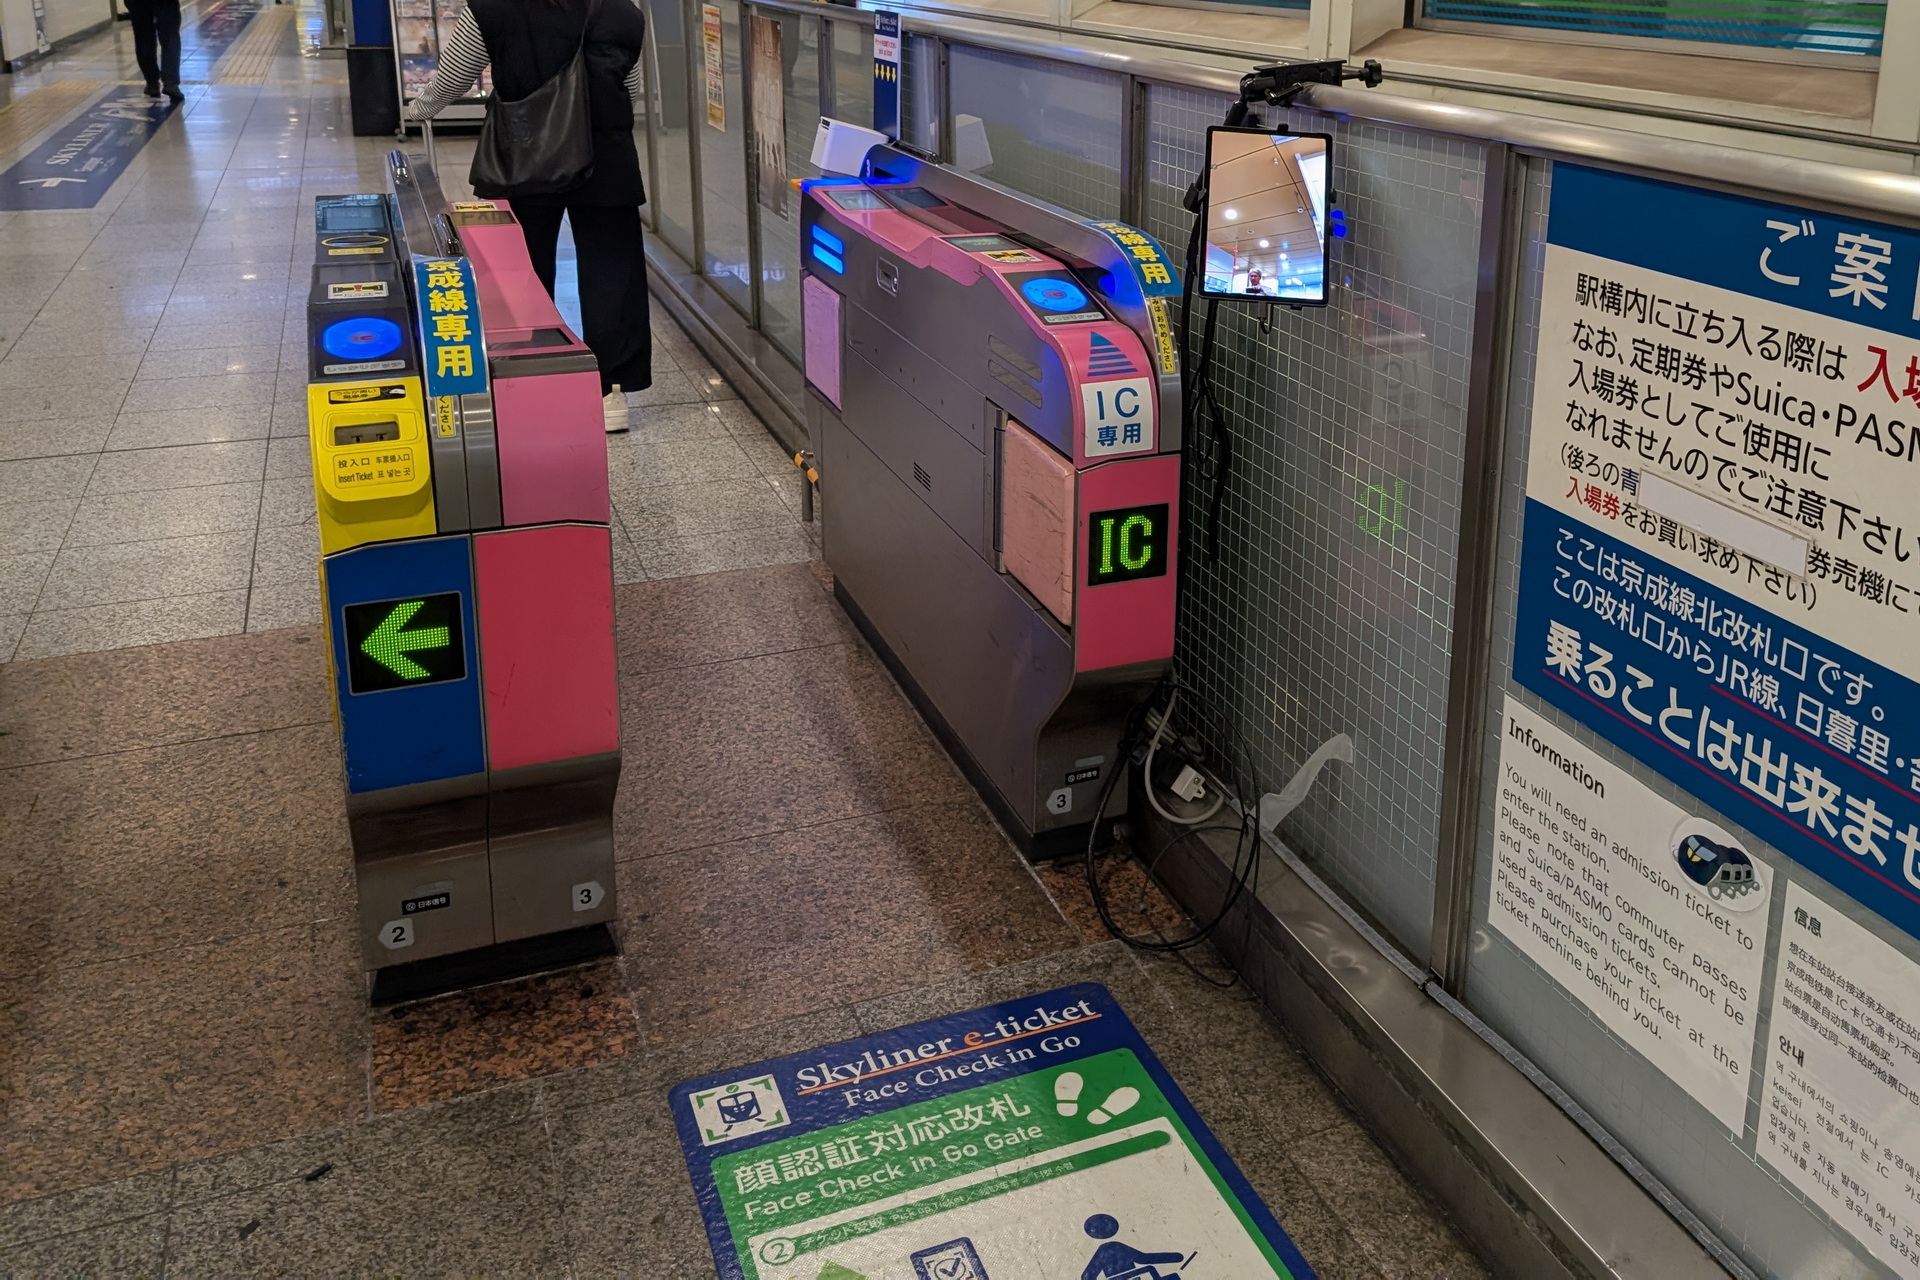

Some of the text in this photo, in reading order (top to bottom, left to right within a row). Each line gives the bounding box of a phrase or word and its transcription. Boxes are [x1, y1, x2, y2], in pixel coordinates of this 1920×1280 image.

[1759, 219, 1920, 322] ご案
[423, 260, 474, 378] 京成線専用
[1156, 315, 1173, 370] おやめください
[1574, 272, 1848, 381] 駅構内に立ち入る際は
[1097, 387, 1140, 421] IC
[1097, 422, 1142, 448] 専用
[1568, 359, 1831, 481] 入場券としてご使用に
[338, 457, 370, 469] 投入口
[338, 471, 374, 484] Insert Ticket
[1099, 515, 1152, 574] IC
[1807, 546, 1920, 617] 券売機に
[1556, 528, 1885, 722] ここは京成線北改札口です。
[1508, 717, 1604, 798] Information
[1057, 794, 1066, 808] 3
[1503, 788, 1610, 873] enter the station.
[580, 889, 592, 904] 3
[1505, 762, 1753, 950] You will need an admission ticket to
[391, 926, 406, 943] 2
[417, 896, 447, 909] 日本信号
[1499, 851, 1661, 989] used as admission tickets.
[1500, 831, 1745, 1026] and Suica/PASMO cards cannot be
[1501, 806, 1748, 1001] Please note that commuter passes
[1794, 906, 1822, 938] 信息
[1496, 890, 1662, 1040] ticket machine behind you.
[1497, 869, 1739, 1075] Please purchase your ticket at the
[1787, 960, 1834, 1002] 京成电铁是
[1835, 994, 1849, 1012] IC
[797, 1000, 1096, 1090] Skyliner e-ticket
[843, 1036, 1081, 1108] Face Check in Go
[1779, 1035, 1805, 1068] 안내
[733, 1093, 1031, 1194] 顔認証対応改札
[1773, 1077, 1802, 1109] keisei
[1816, 1112, 1854, 1151] 전철에서
[1875, 1161, 1890, 1179] IC
[1776, 1060, 1784, 1075] 역
[1788, 1071, 1835, 1115] 구내에서의
[1839, 1113, 1879, 1150] 쇼핑이나
[744, 1124, 1043, 1220] Face Check in Go Gate
[1770, 1113, 1796, 1143] 입장권
[1817, 1152, 1836, 1175] 자동
[1841, 1171, 1870, 1204] 발매기
[1876, 1203, 1896, 1227] 에서
[1812, 1168, 1840, 1199] 지나는
[1845, 1196, 1883, 1236] 경우에도
